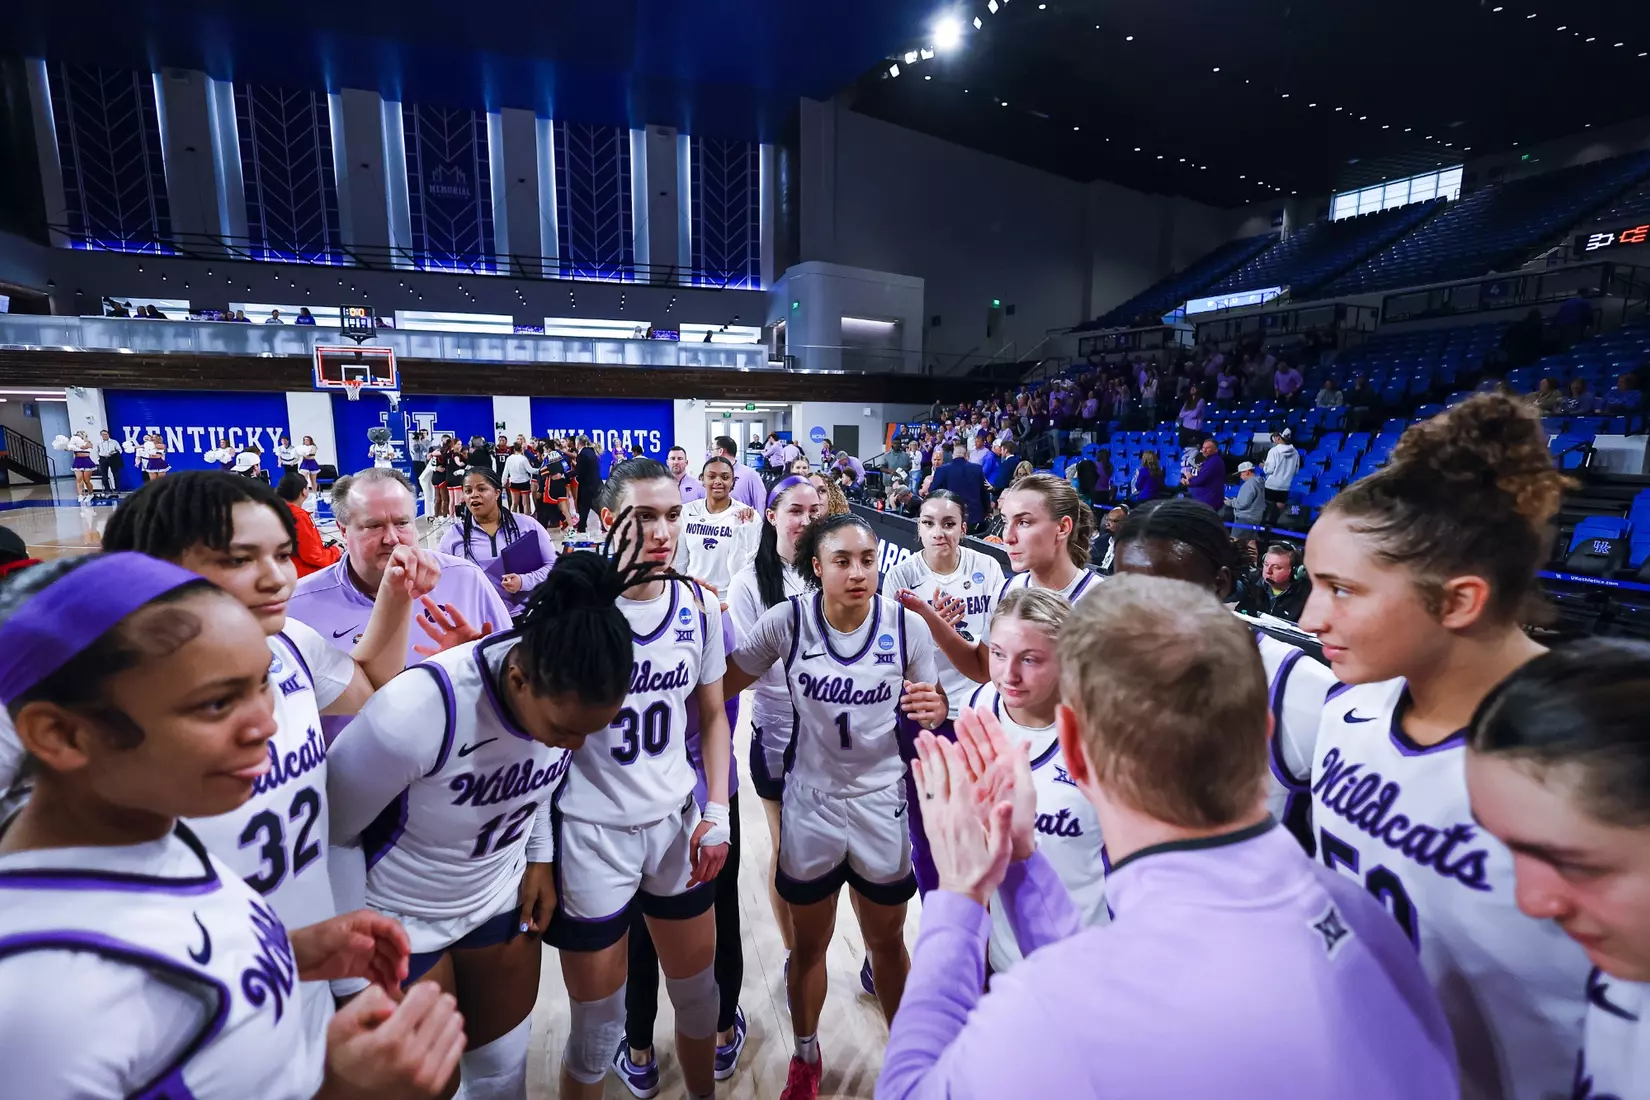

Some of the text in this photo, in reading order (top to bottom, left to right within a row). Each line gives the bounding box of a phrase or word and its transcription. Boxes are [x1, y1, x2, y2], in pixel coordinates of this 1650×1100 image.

[428, 184, 471, 196] MEMORIAL
[547, 429, 661, 452] DCATS
[686, 523, 719, 537] NOTHING
[966, 595, 992, 615] EASY
[798, 672, 892, 705] Wildcats
[610, 700, 672, 766] 30
[834, 711, 853, 750] 1
[250, 724, 327, 798] dcat
[470, 801, 539, 859] 12
[1034, 807, 1084, 837] ats
[1312, 747, 1493, 892] Wildcats
[237, 785, 323, 898] 32
